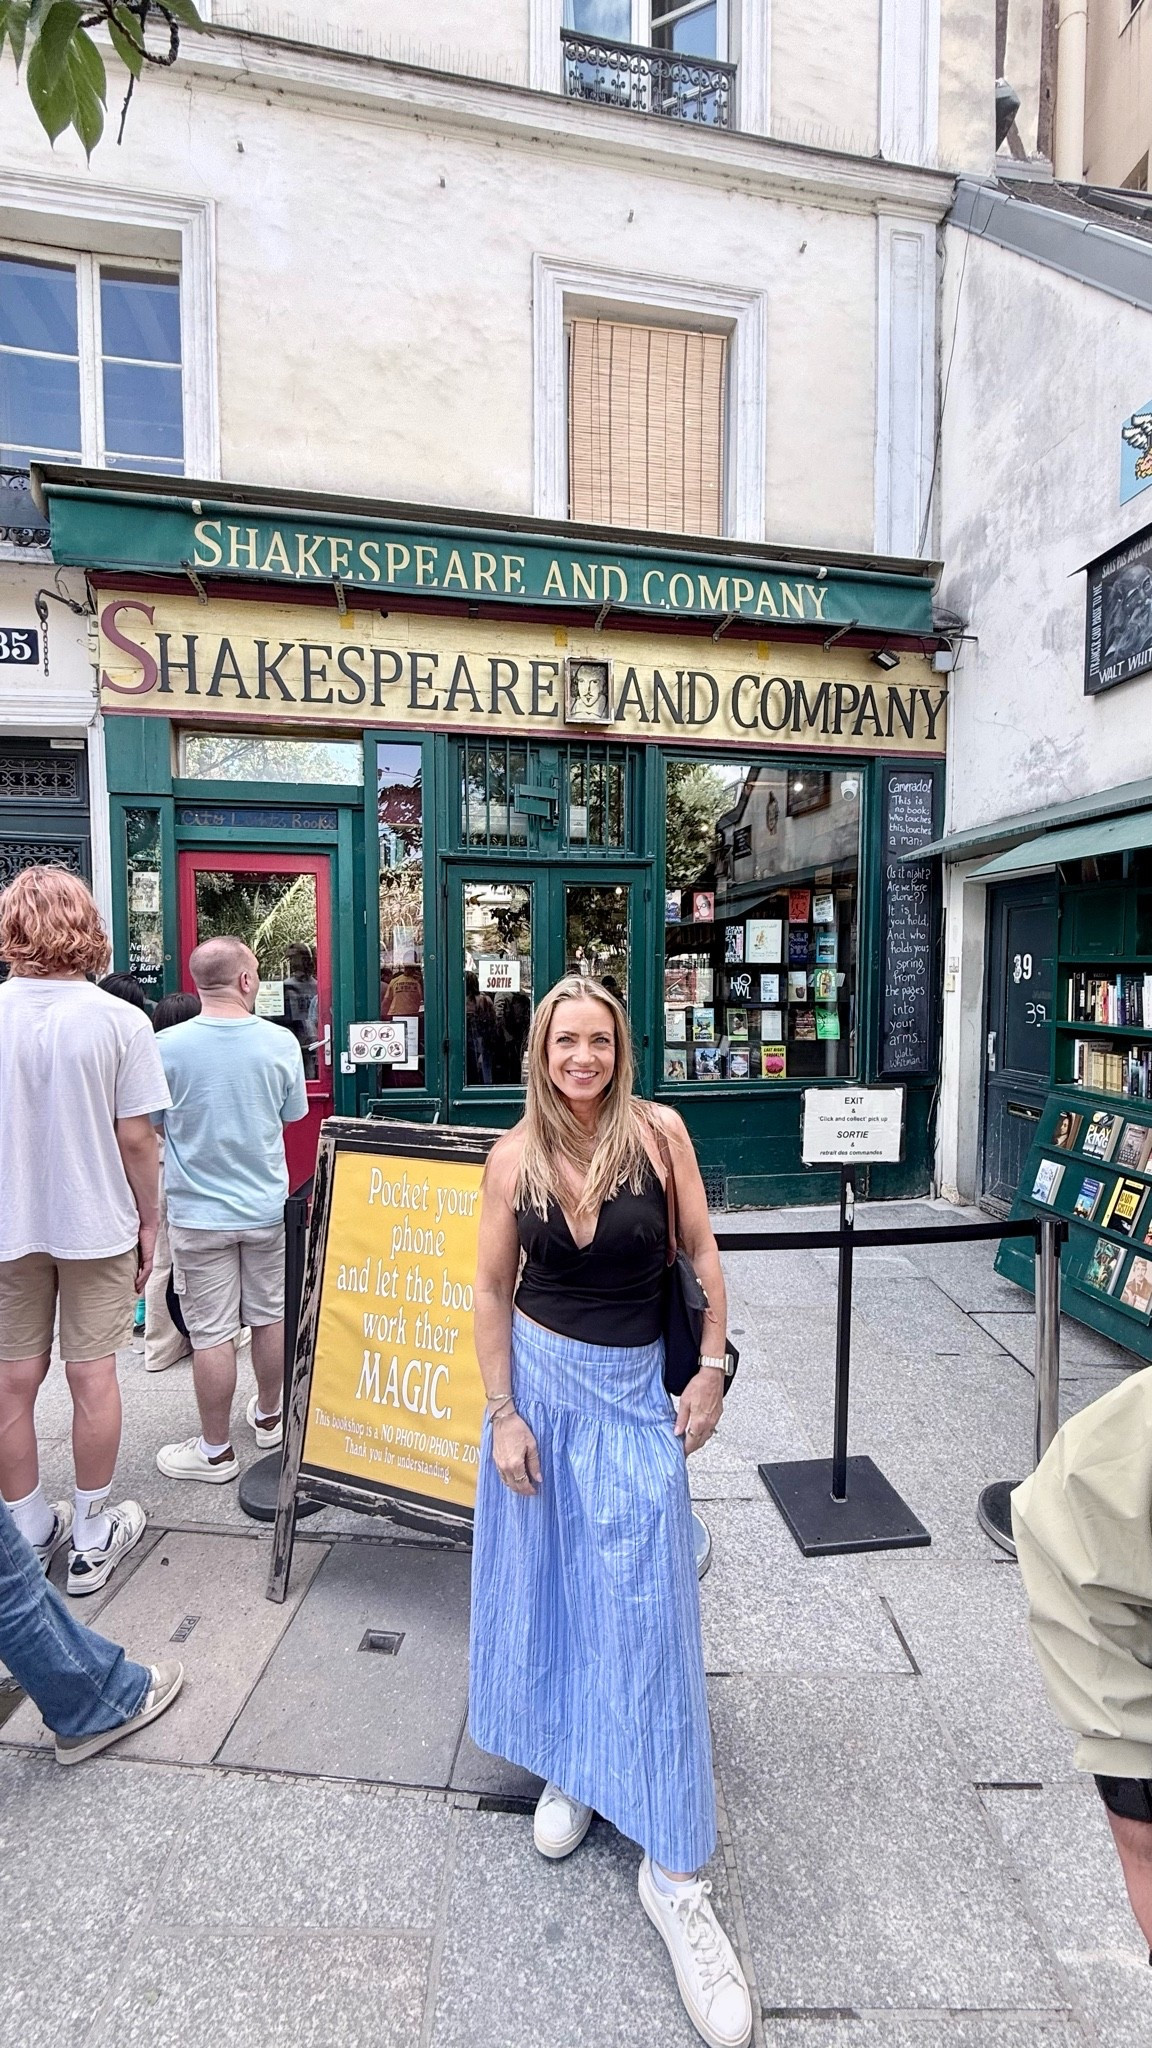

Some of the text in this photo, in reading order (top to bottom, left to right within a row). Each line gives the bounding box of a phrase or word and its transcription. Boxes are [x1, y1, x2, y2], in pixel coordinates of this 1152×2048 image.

[193, 520, 829, 620] SHAKESPEARE AND COMPANY
[0, 631, 32, 661] 35
[101, 599, 950, 740] SHAKESPEARE AND COMPANY
[1099, 647, 1152, 684] WALT WHIT
[888, 777, 933, 793] Camerado!
[891, 795, 923, 805] This is
[894, 806, 905, 814] no
[904, 814, 932, 824] touches
[905, 825, 932, 835] touches
[889, 837, 896, 846] a
[898, 865, 905, 879] it
[906, 865, 931, 884] night?
[887, 882, 928, 892] Are we here
[891, 890, 925, 904] alone?)
[888, 904, 895, 916] It
[901, 904, 910, 915] is
[890, 916, 905, 930] you
[887, 929, 926, 941] And who
[891, 940, 913, 954] holds
[129, 953, 152, 963] Used
[129, 962, 161, 972] & Rare
[489, 964, 509, 975] EXIT
[896, 958, 925, 974] spring
[132, 974, 158, 984] ooks
[486, 977, 512, 989] SORTIE
[893, 970, 916, 986] from
[885, 985, 925, 1001] the pages
[893, 1002, 915, 1016] into
[1025, 1002, 1047, 1025] 39
[889, 1018, 915, 1034] your
[844, 1096, 865, 1105] EXIT
[836, 1130, 870, 1139] SORTIE
[368, 1166, 479, 1224] Pocket your
[389, 1213, 446, 1260] phone
[336, 1256, 476, 1313] and let the boo
[362, 1305, 459, 1355] work their
[355, 1350, 452, 1421] MAGIC.
[315, 1407, 481, 1465] This bookshop is a NO PHOTO/PHONE ZON
[344, 1436, 452, 1486] Thank you for understanding.
